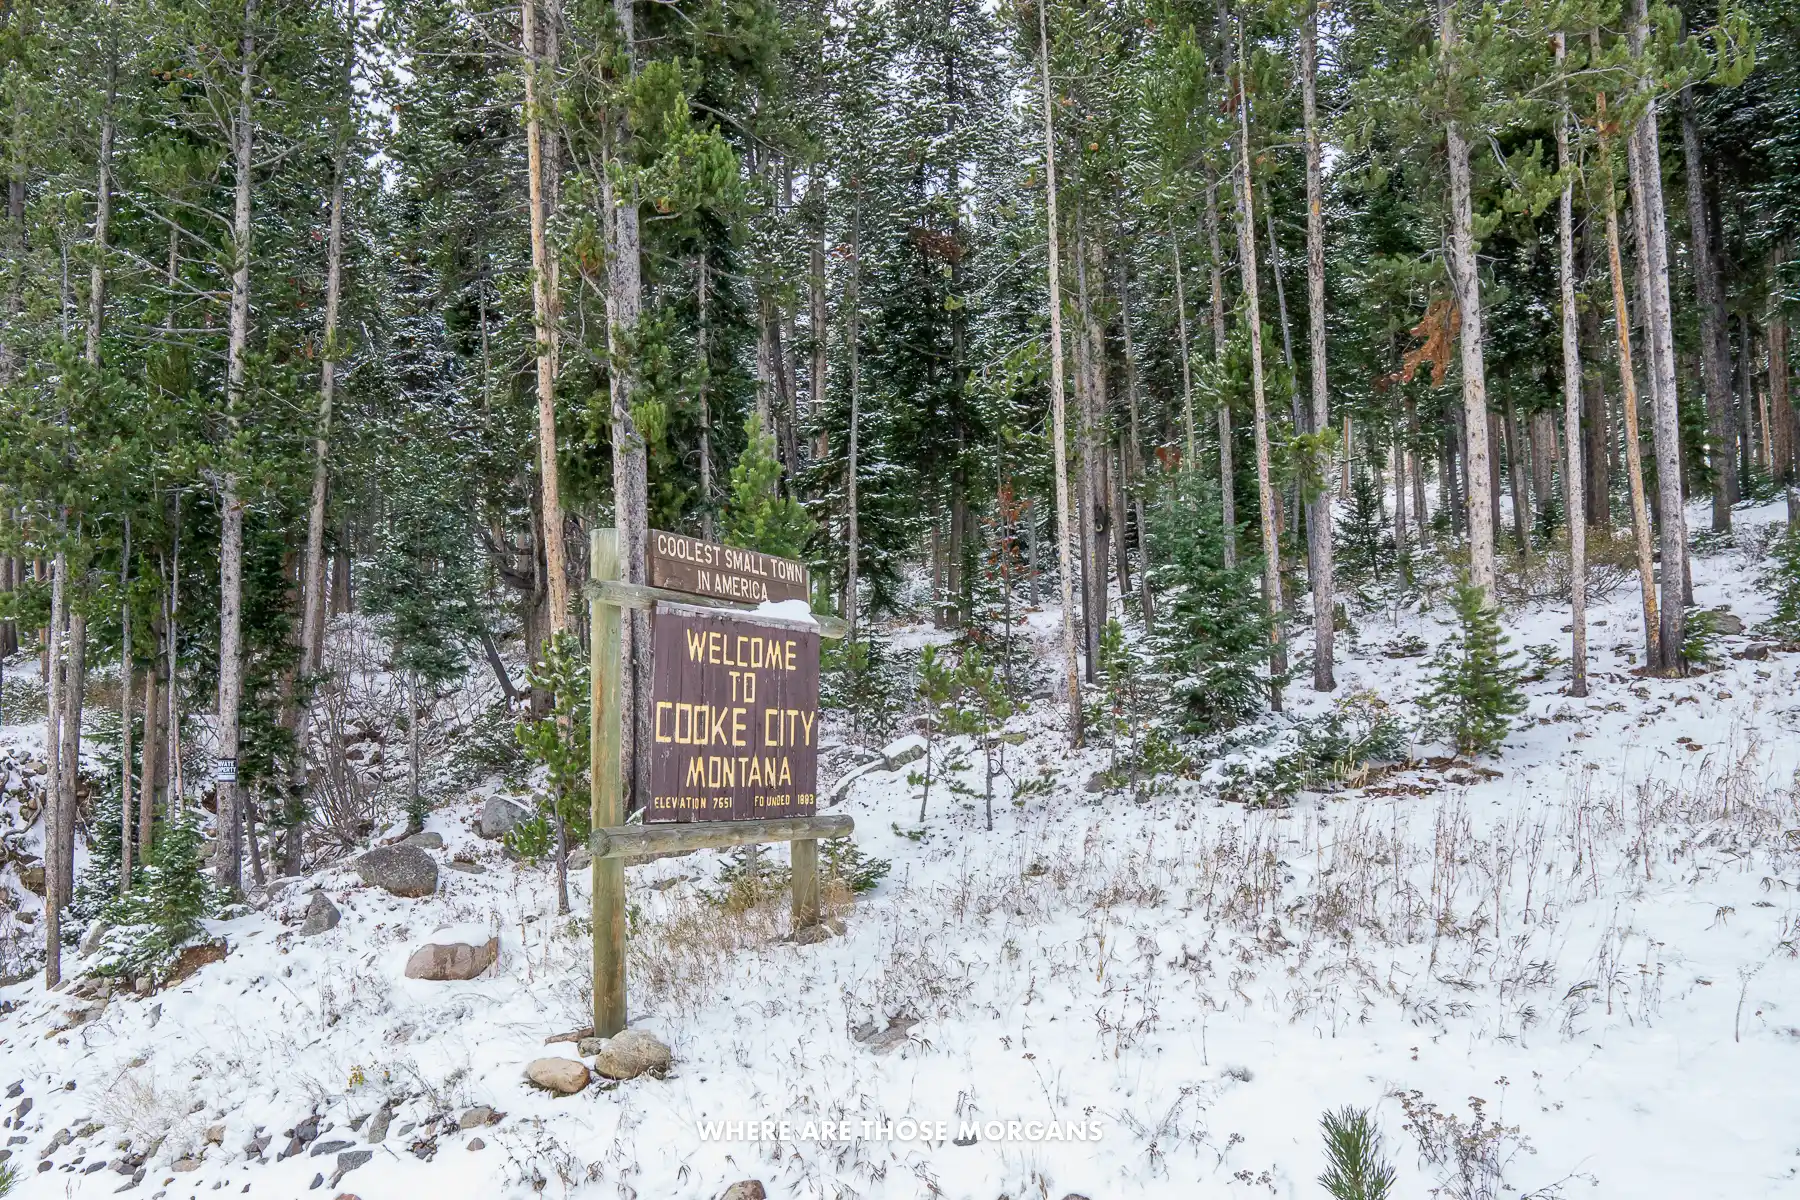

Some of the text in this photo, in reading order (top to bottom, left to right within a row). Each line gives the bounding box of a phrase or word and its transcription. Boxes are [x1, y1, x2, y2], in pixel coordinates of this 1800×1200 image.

[657, 534, 803, 584] COOLEST SMALL TOWN
[697, 569, 768, 601] IN AMERICA
[686, 628, 797, 671] WELCOME
[728, 671, 756, 703] TO
[655, 701, 815, 747] COOKE CITY
[685, 753, 792, 788] MONTANA
[654, 793, 814, 809] ELEVATION 7651 FOUNDED 1883
